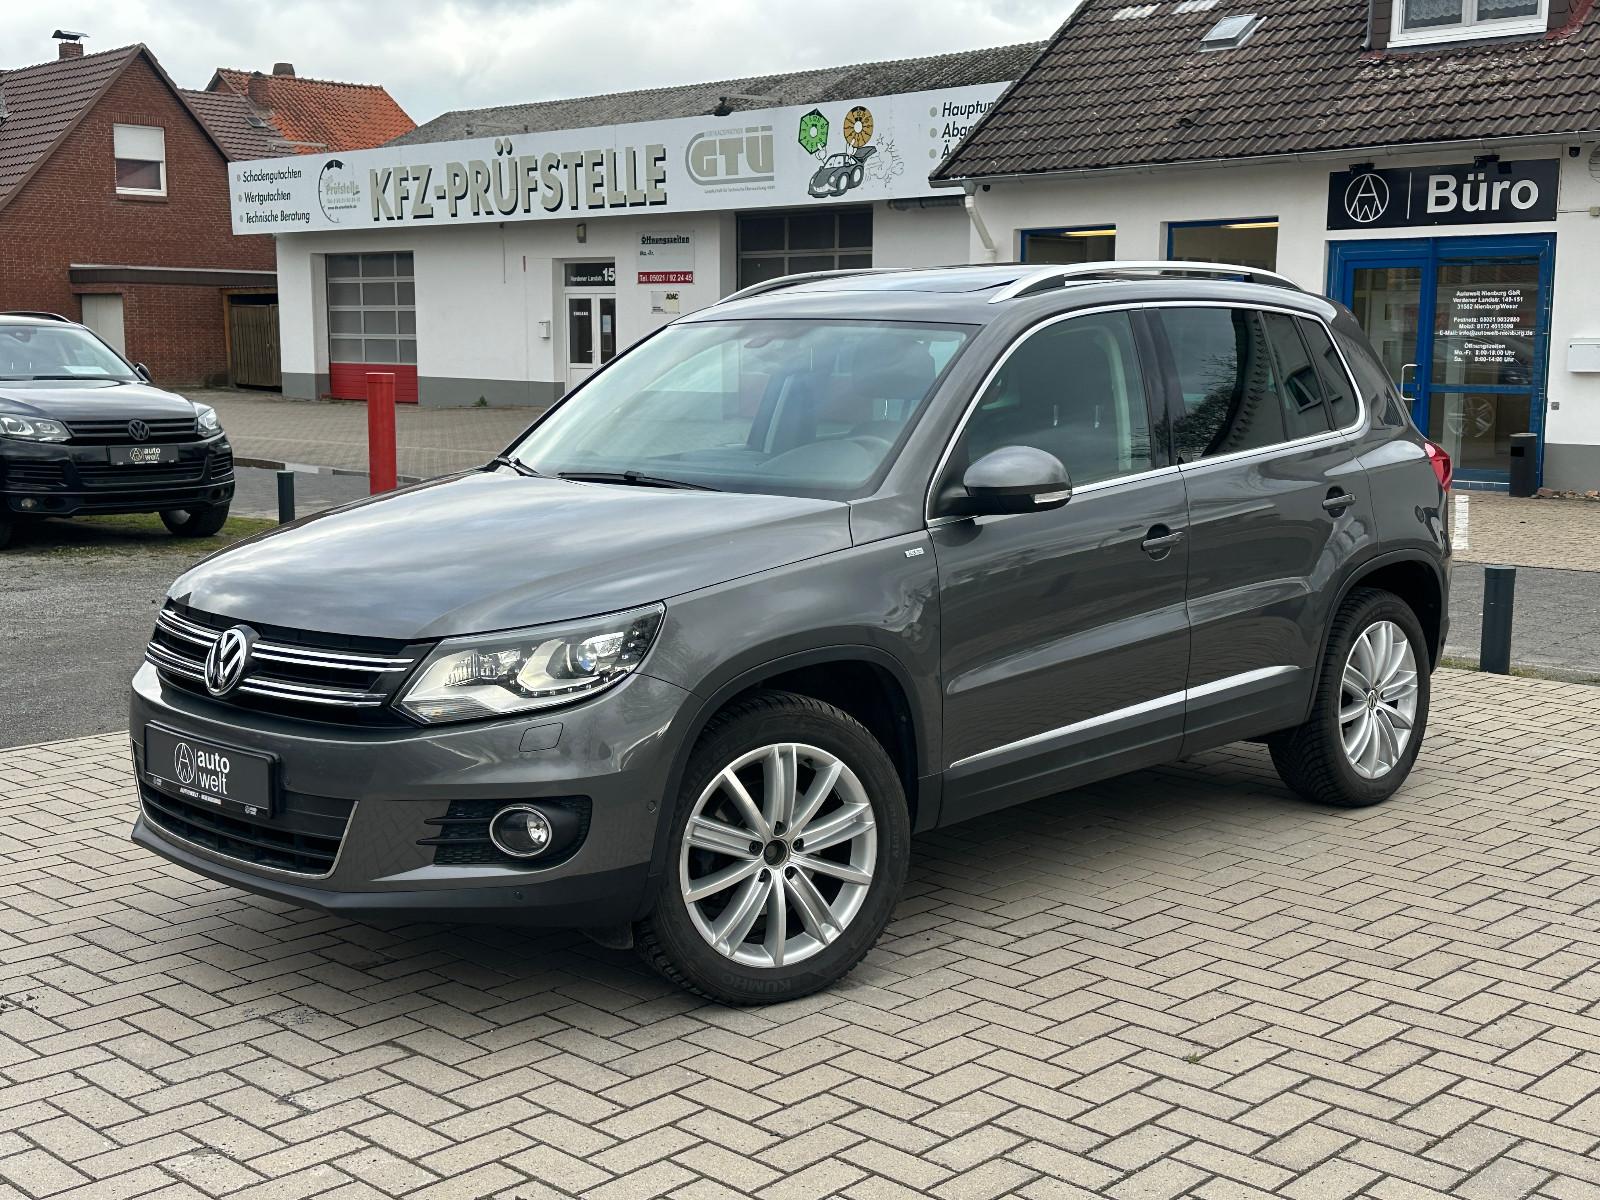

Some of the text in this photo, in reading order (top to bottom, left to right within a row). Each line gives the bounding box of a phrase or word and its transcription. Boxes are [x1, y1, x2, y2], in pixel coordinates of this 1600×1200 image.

[242, 168, 302, 183] Schadengutachten
[369, 137, 667, 221] KFZ-PRÜFSTELLE
[244, 191, 291, 206] Wertgutachten
[1426, 172, 1539, 214] Büro
[245, 210, 311, 224] Technische Beratung
[602, 267, 616, 282] 15
[197, 750, 230, 774] auto
[199, 771, 228, 795] welt
